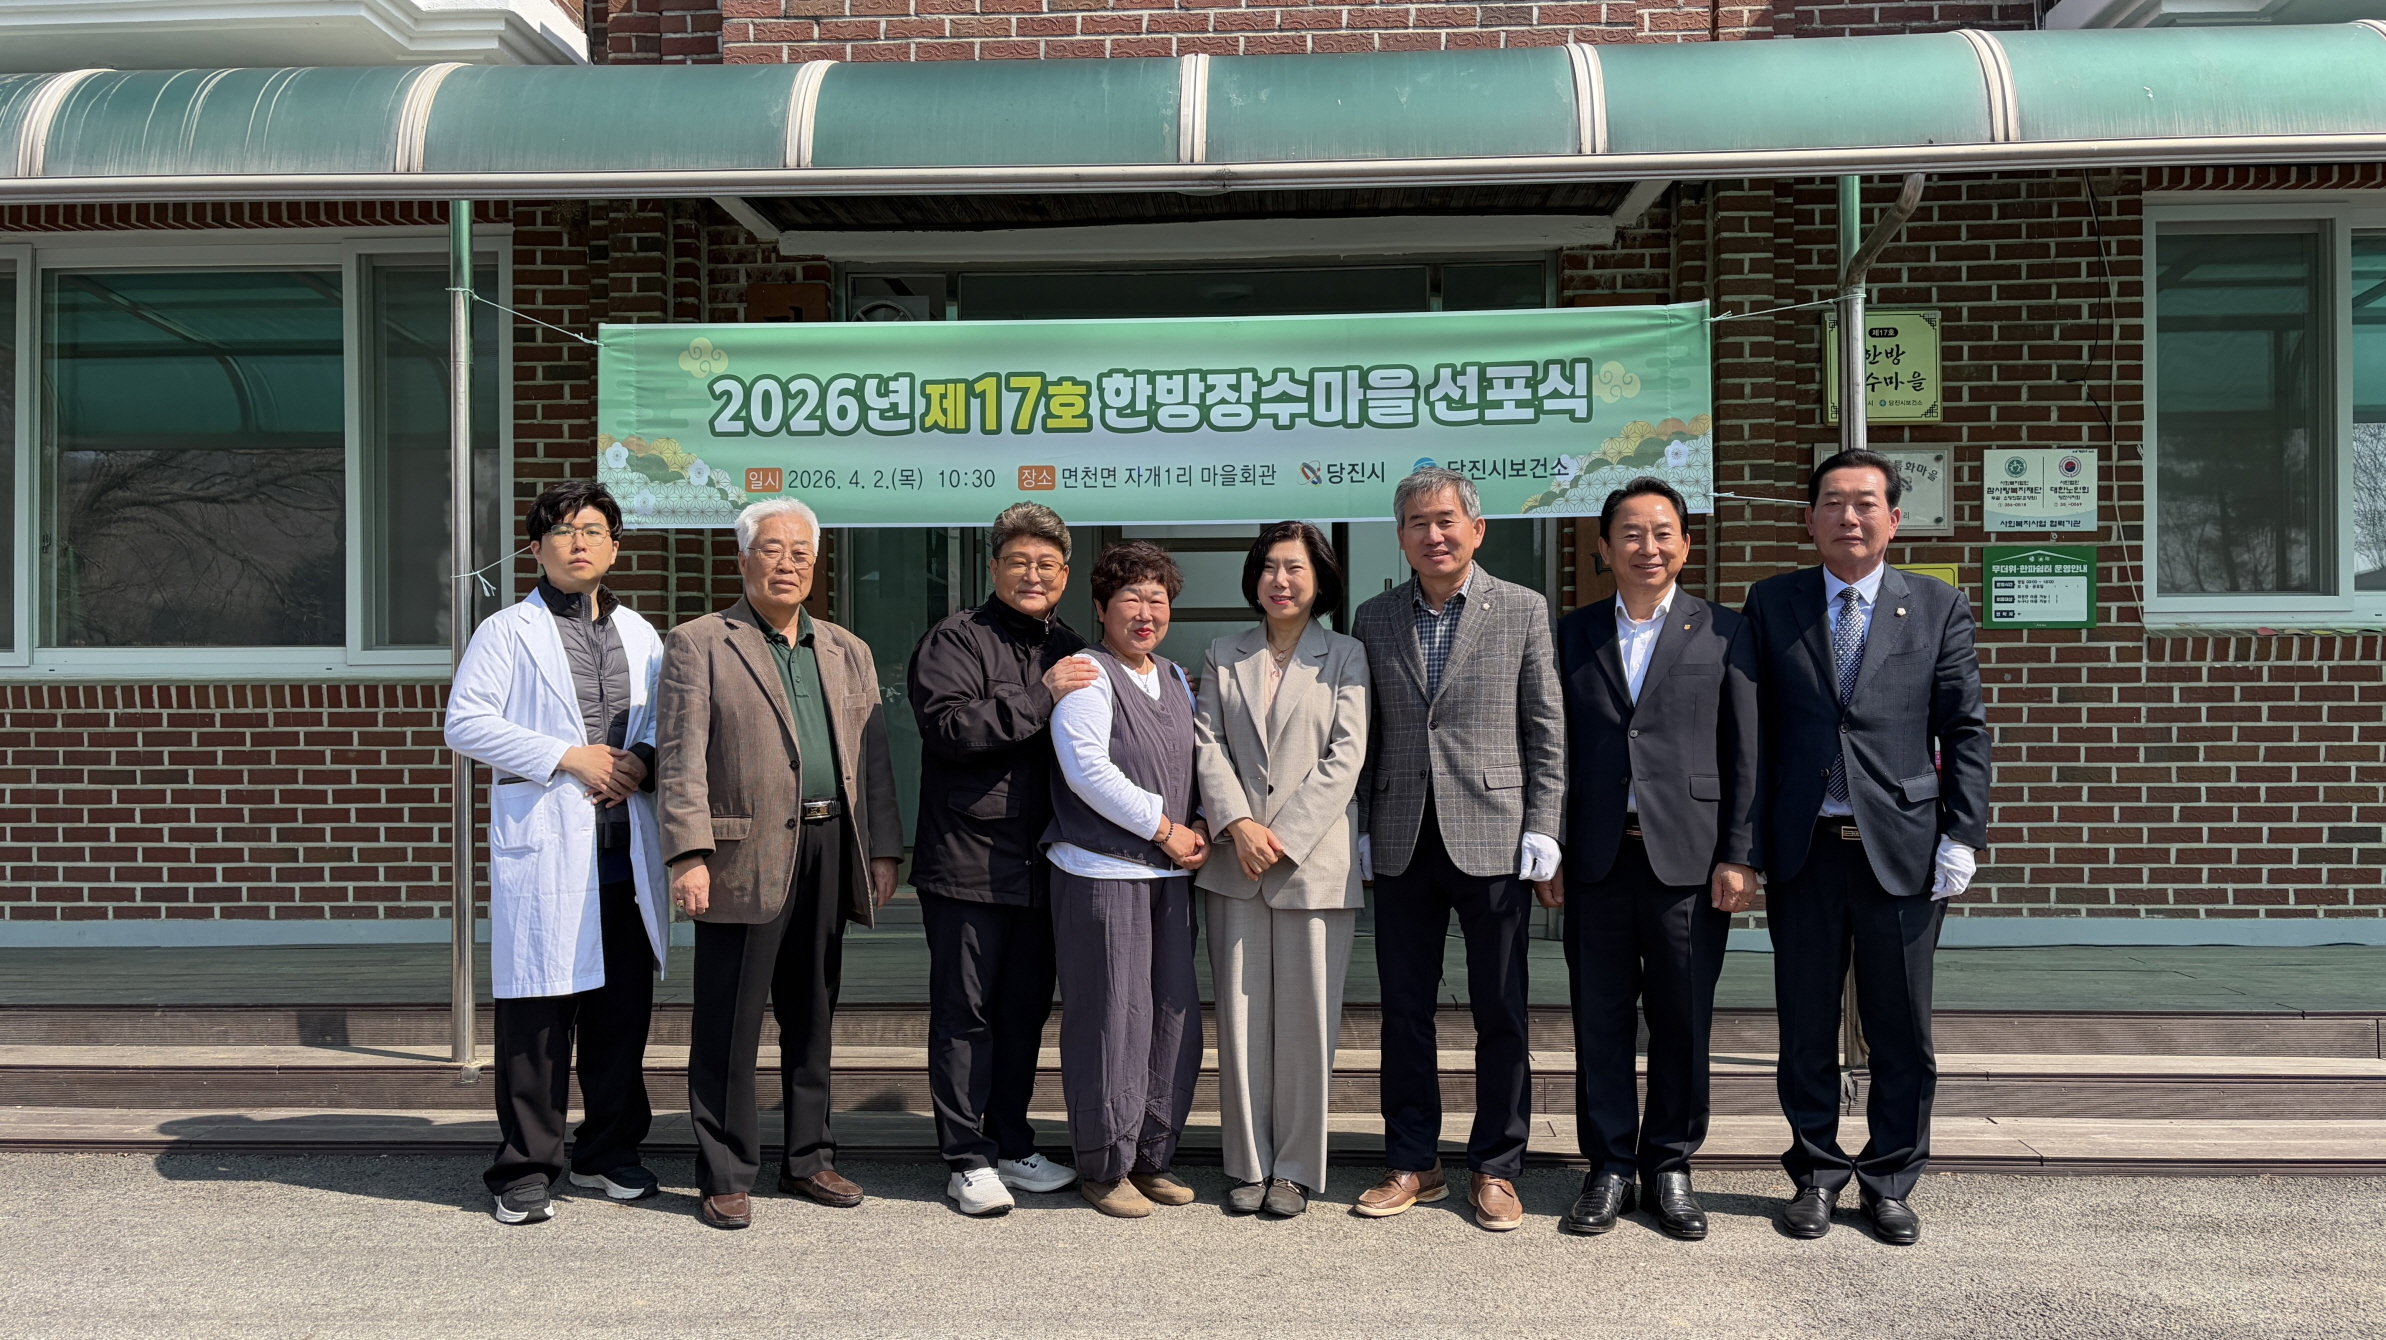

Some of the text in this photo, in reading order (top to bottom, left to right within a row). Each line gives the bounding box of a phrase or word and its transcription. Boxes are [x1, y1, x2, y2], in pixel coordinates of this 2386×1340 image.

[1871, 329, 1896, 337] 제17호
[1865, 343, 1907, 366] 한방
[1865, 370, 1927, 393] 수마을
[710, 359, 1592, 436] 2026년 제17호 한방장수마을 선포식
[1888, 399, 1923, 407] 당진시보건소
[748, 463, 1277, 490] 일시 2026. 4. 2.(목) 10:30 장소 면천면 자개1리 마을회관
[1326, 461, 1386, 484] 당진시
[1447, 457, 1570, 481] 당진시보건소
[1987, 486, 2042, 495] 참사랑복지재단
[2050, 486, 2090, 494] 대한노인회
[2000, 520, 2081, 528] 사회복지사업 협력기관
[2054, 564, 2088, 574] 운영안내
